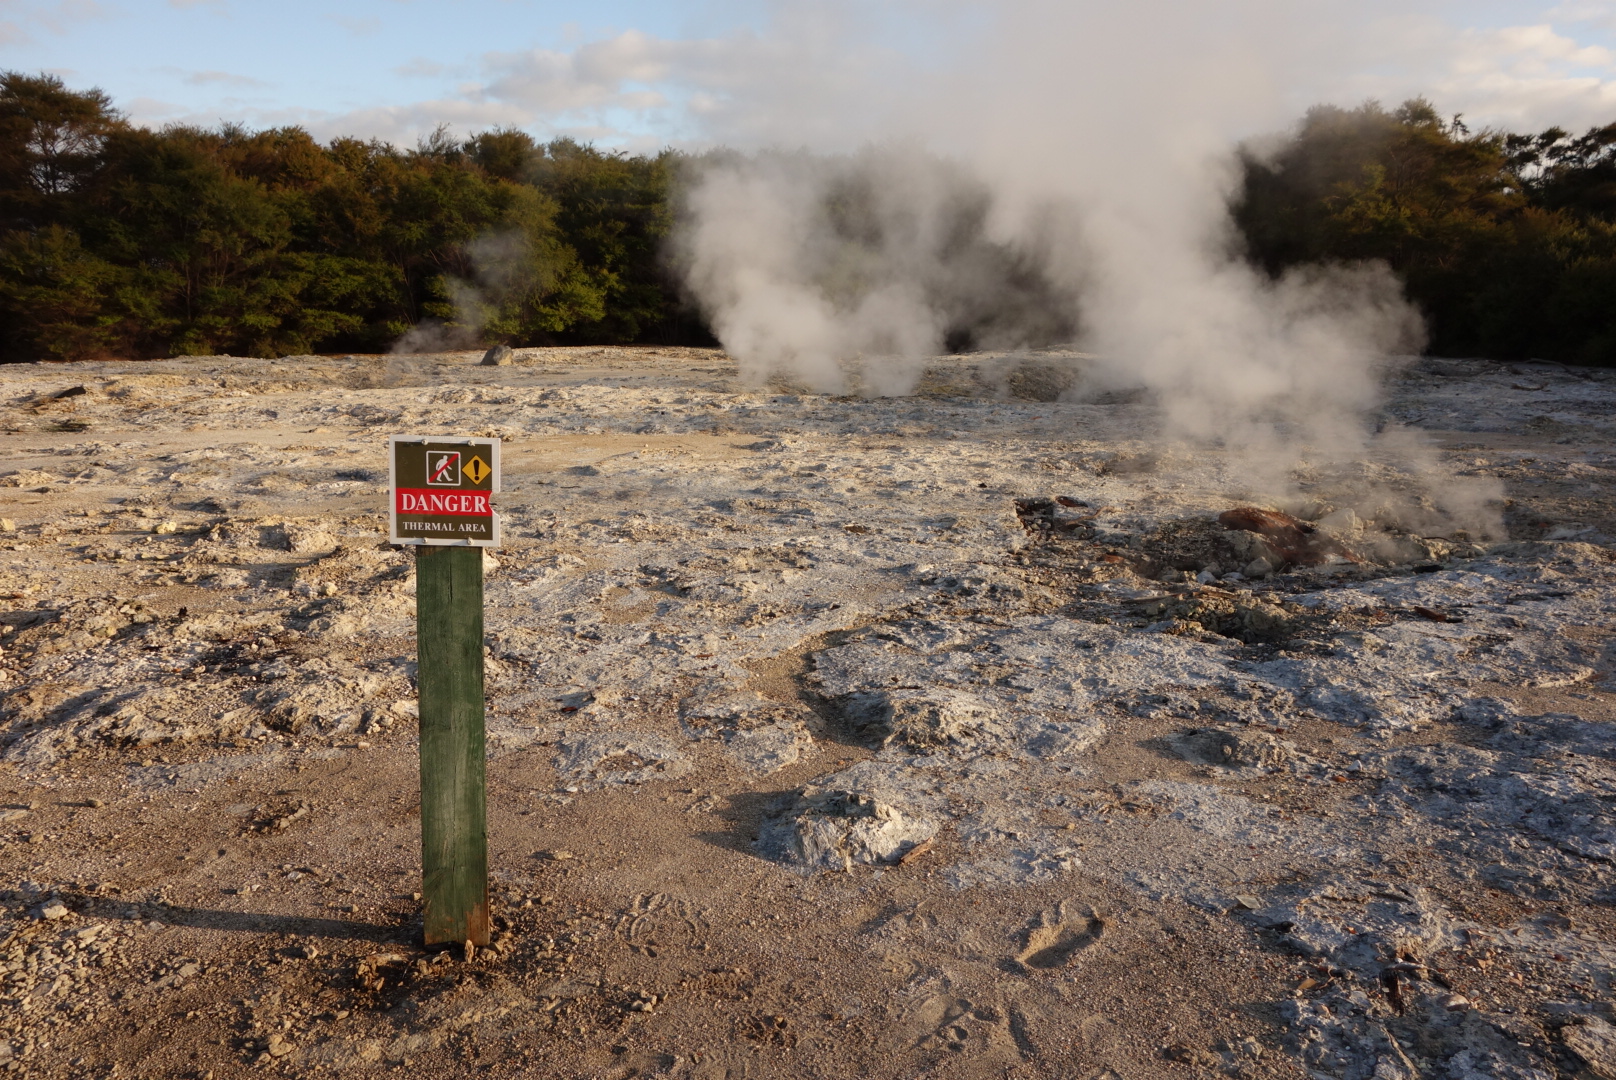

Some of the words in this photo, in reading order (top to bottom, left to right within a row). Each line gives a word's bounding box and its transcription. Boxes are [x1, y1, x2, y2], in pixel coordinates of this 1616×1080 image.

[401, 493, 487, 513] DANGER
[403, 521, 455, 532] THERMAL
[458, 523, 486, 533] AREA
